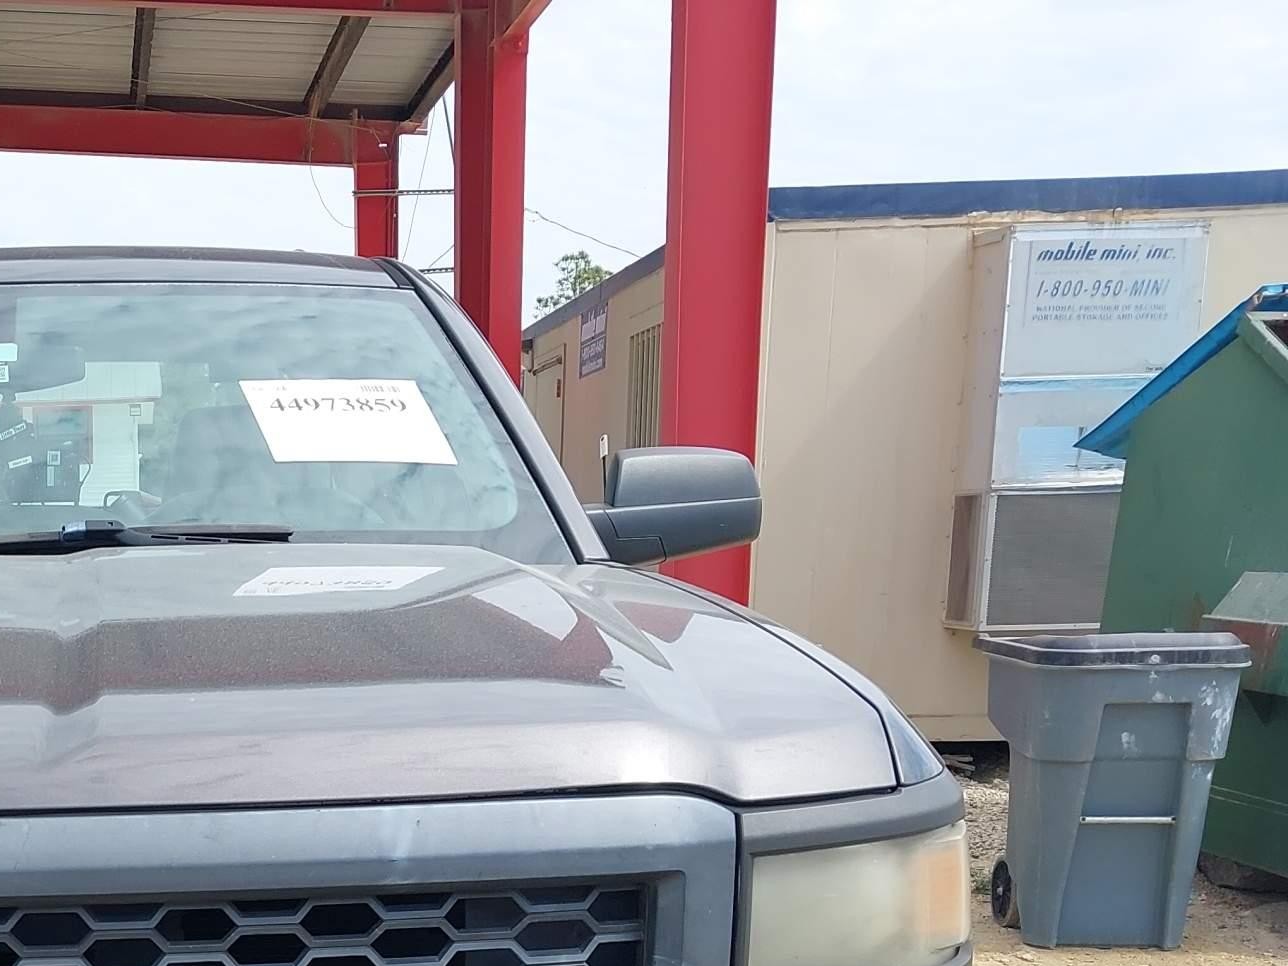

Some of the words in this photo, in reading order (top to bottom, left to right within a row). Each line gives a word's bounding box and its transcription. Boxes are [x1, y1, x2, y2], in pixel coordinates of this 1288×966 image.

[1036, 240, 1098, 262] mobile
[1145, 244, 1177, 260] inc.
[1035, 278, 1171, 299] 1-800-950-MINI
[269, 397, 407, 412] 44973859
